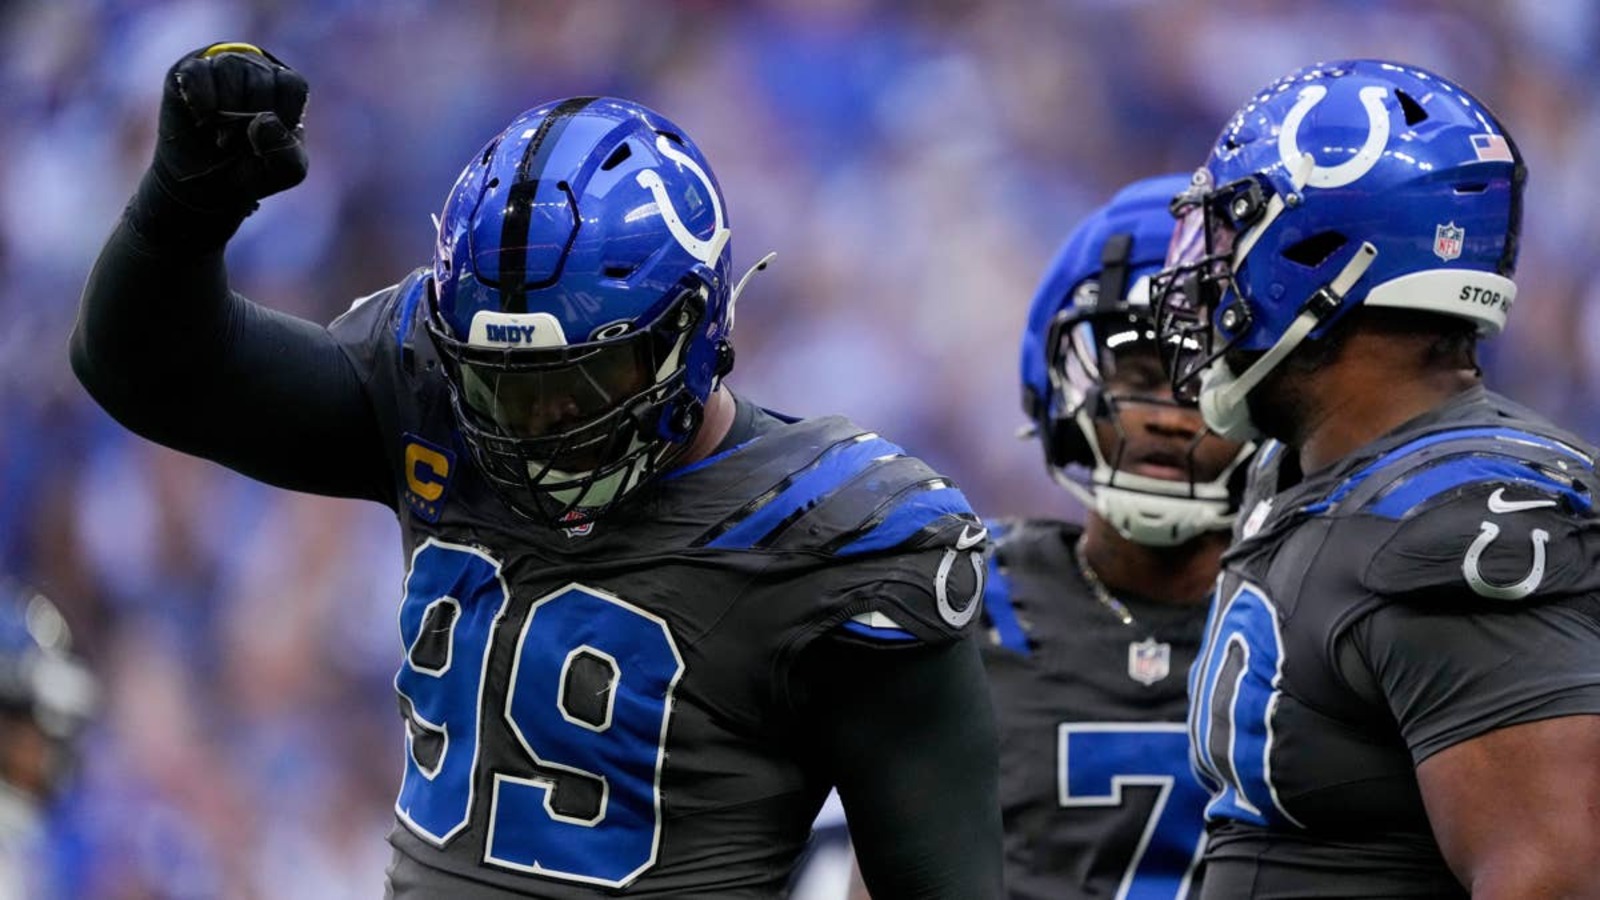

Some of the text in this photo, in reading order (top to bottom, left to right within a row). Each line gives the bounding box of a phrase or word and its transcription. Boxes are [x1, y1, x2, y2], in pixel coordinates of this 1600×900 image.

[1439, 238, 1460, 255] NFL
[1460, 285, 1501, 307] STOP
[486, 324, 535, 343] INDY
[405, 443, 449, 501] C
[395, 537, 686, 888] 99
[1058, 722, 1206, 900] 7
